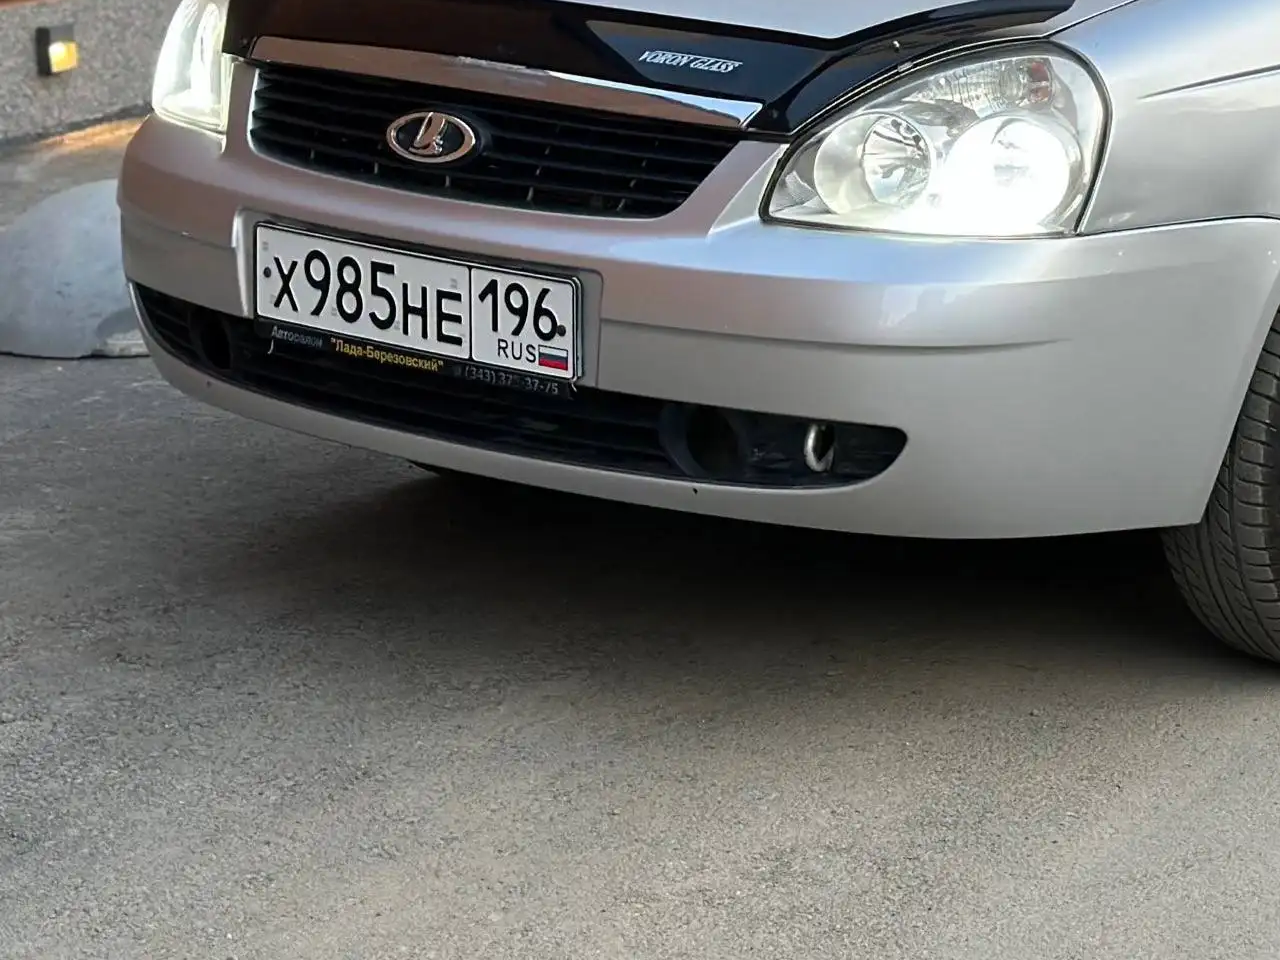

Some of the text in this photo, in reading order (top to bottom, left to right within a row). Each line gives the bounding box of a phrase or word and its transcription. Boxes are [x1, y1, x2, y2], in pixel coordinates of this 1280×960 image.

[638, 50, 743, 73] VORON GLASS
[478, 278, 559, 342] 196
[497, 338, 537, 364] RUS
